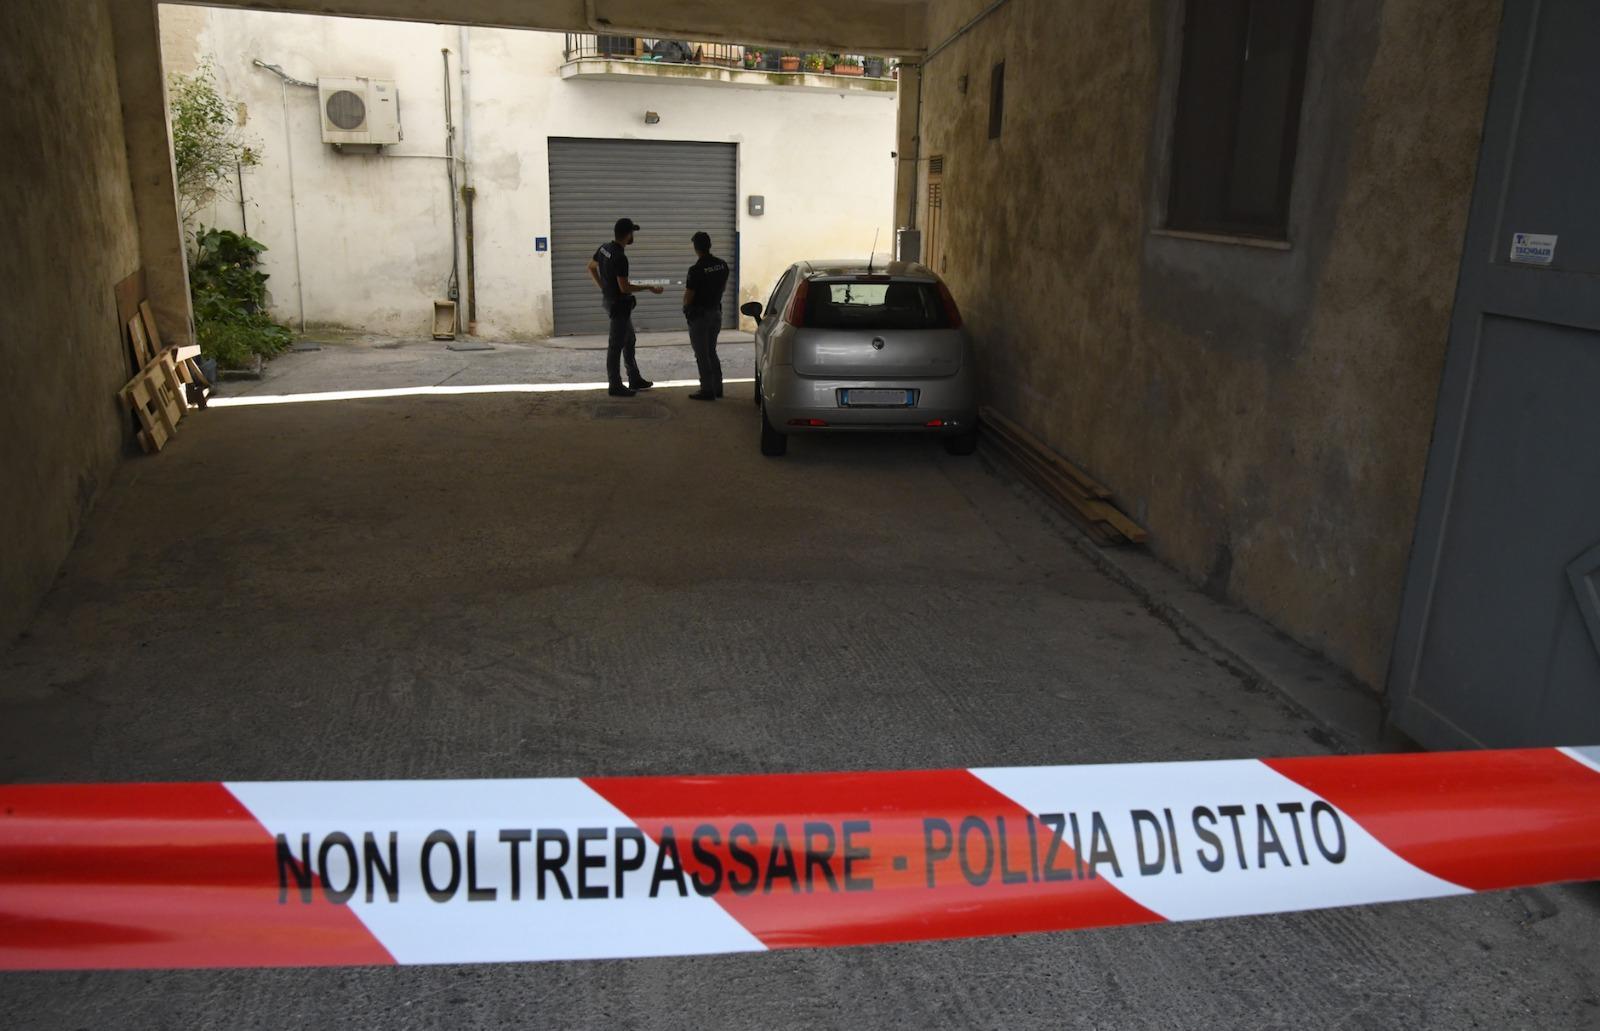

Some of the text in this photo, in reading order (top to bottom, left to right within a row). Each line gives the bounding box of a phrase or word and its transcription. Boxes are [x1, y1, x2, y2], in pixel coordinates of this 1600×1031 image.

[276, 830, 400, 904] NON
[420, 820, 874, 902] OLTREPASSARE
[922, 811, 1124, 888] POLIZIA
[1130, 807, 1183, 877] DI
[1191, 799, 1347, 873] STATO
